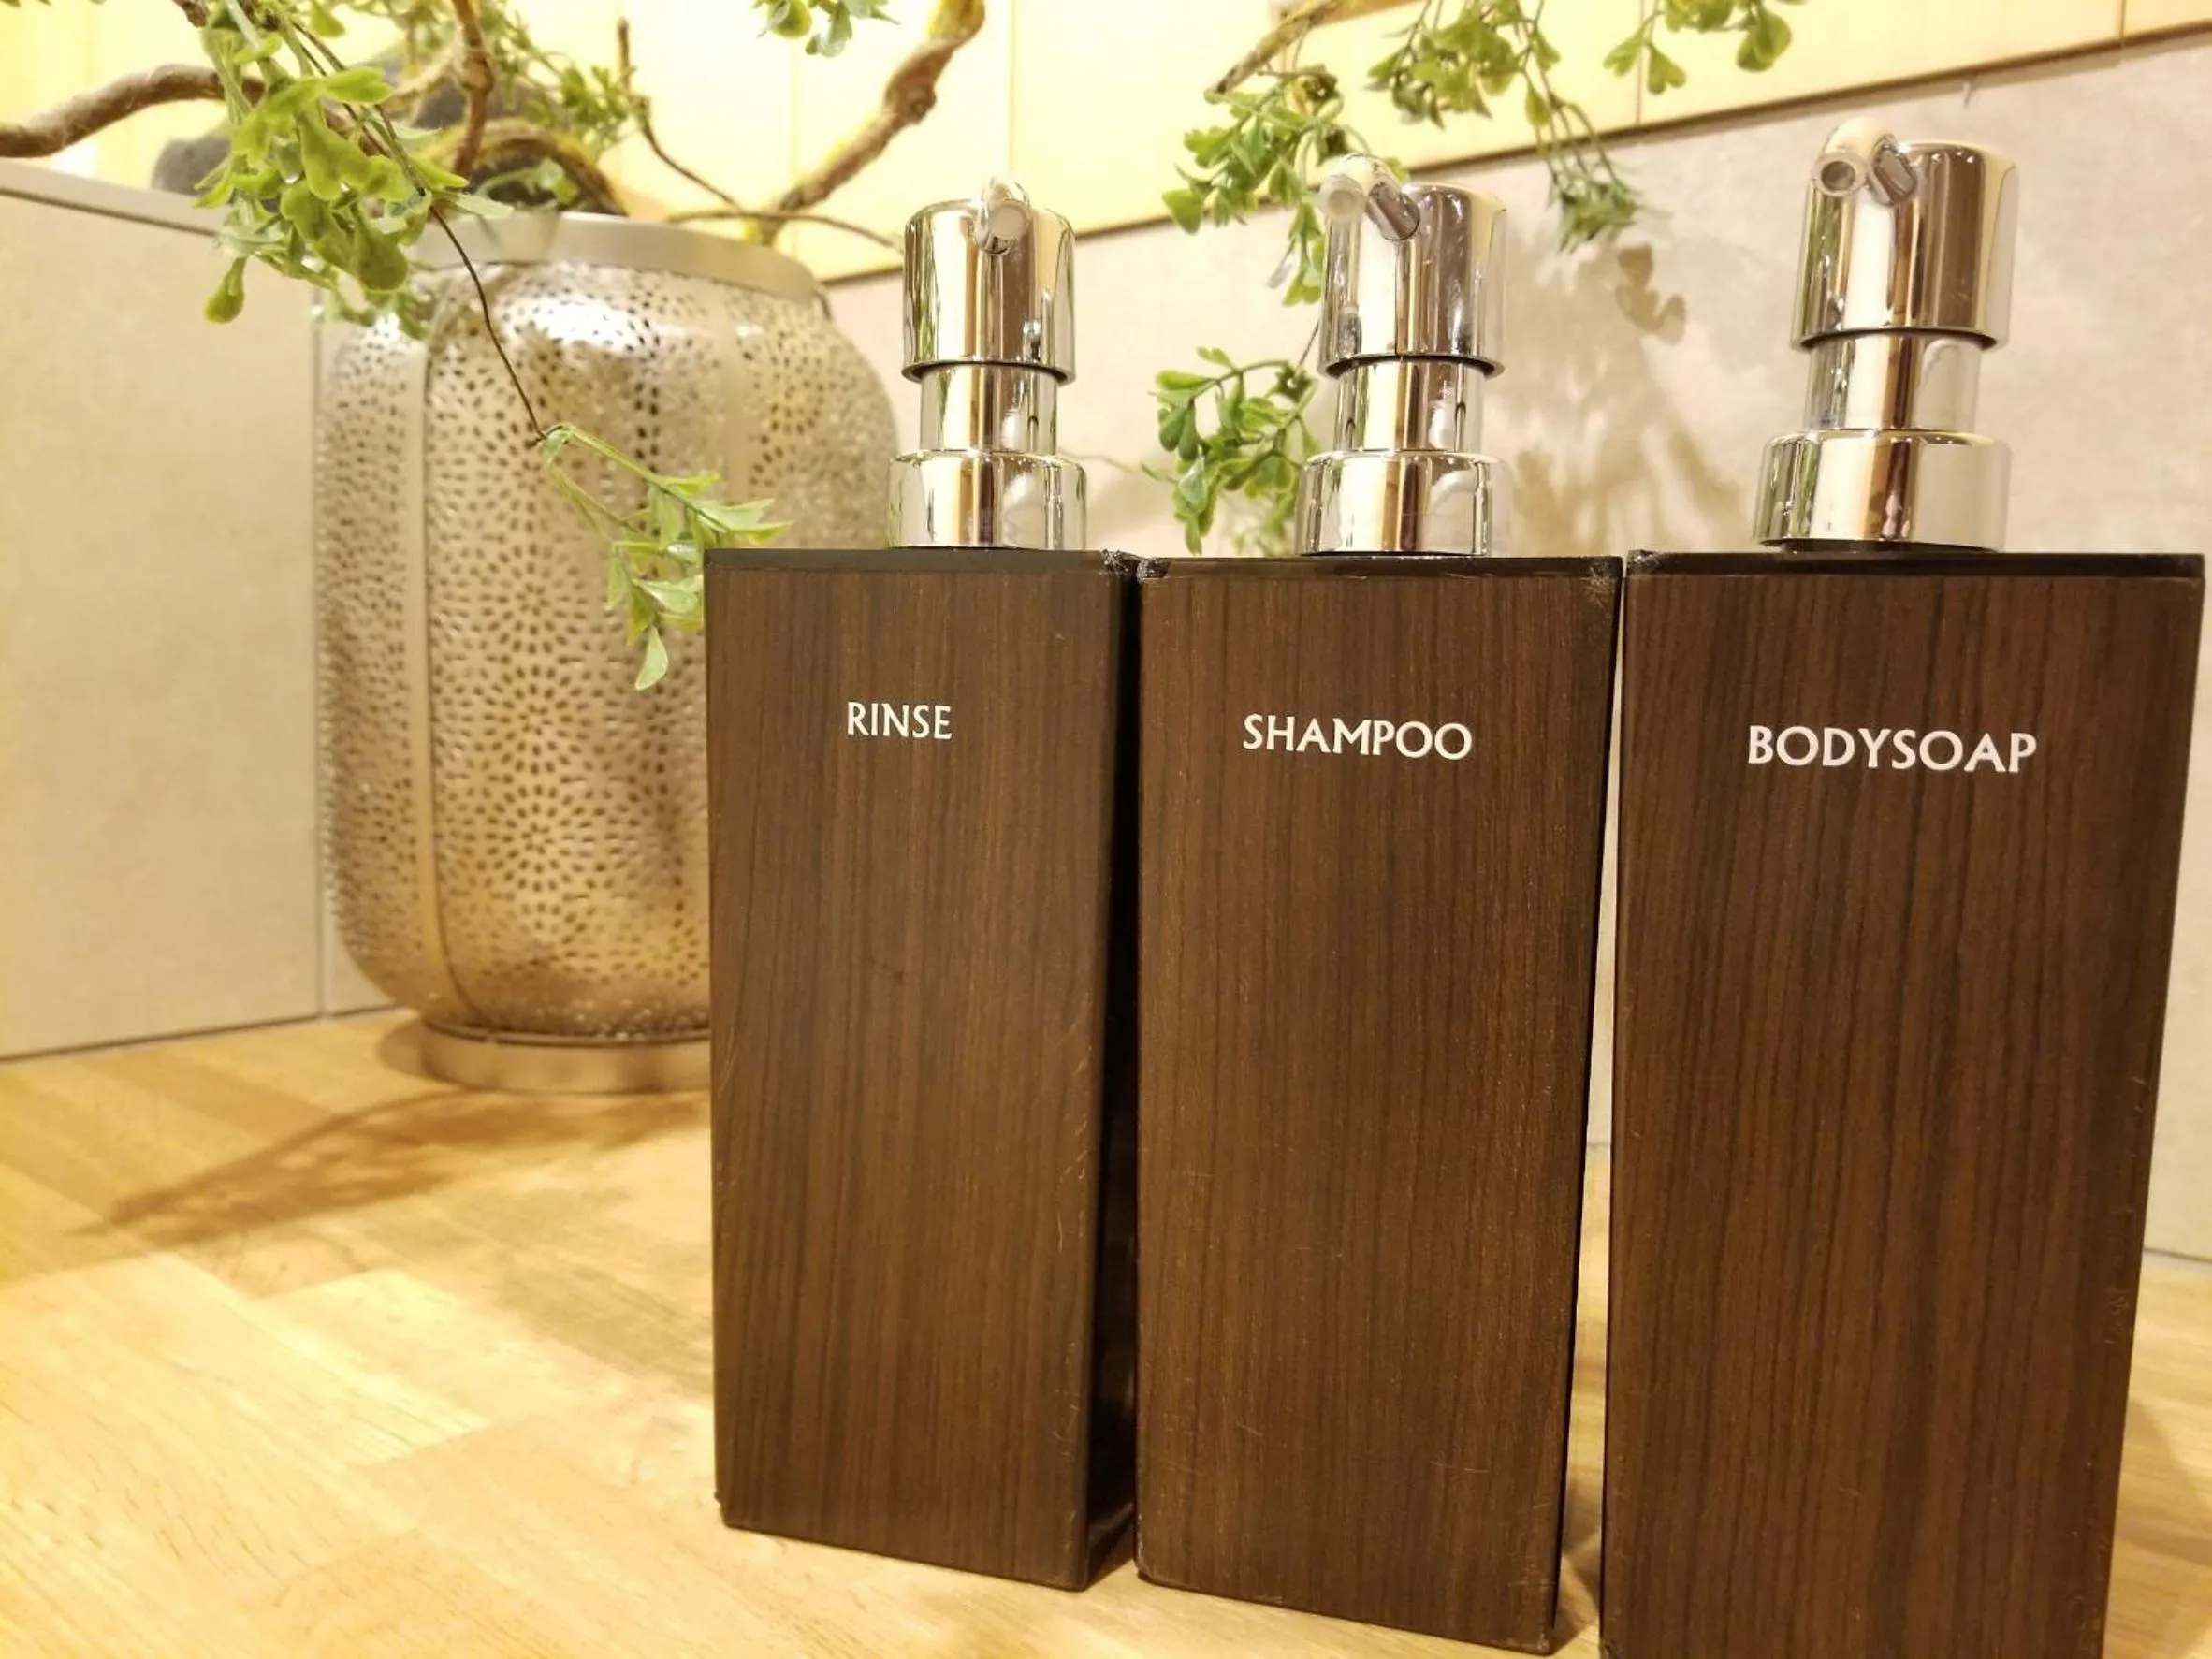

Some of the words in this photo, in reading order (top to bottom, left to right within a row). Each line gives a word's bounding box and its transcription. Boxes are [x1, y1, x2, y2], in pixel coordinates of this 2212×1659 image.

[846, 700, 953, 741] RINSE
[1242, 712, 1474, 761] SHAMPOO
[1747, 724, 2040, 775] BODYSOAP
